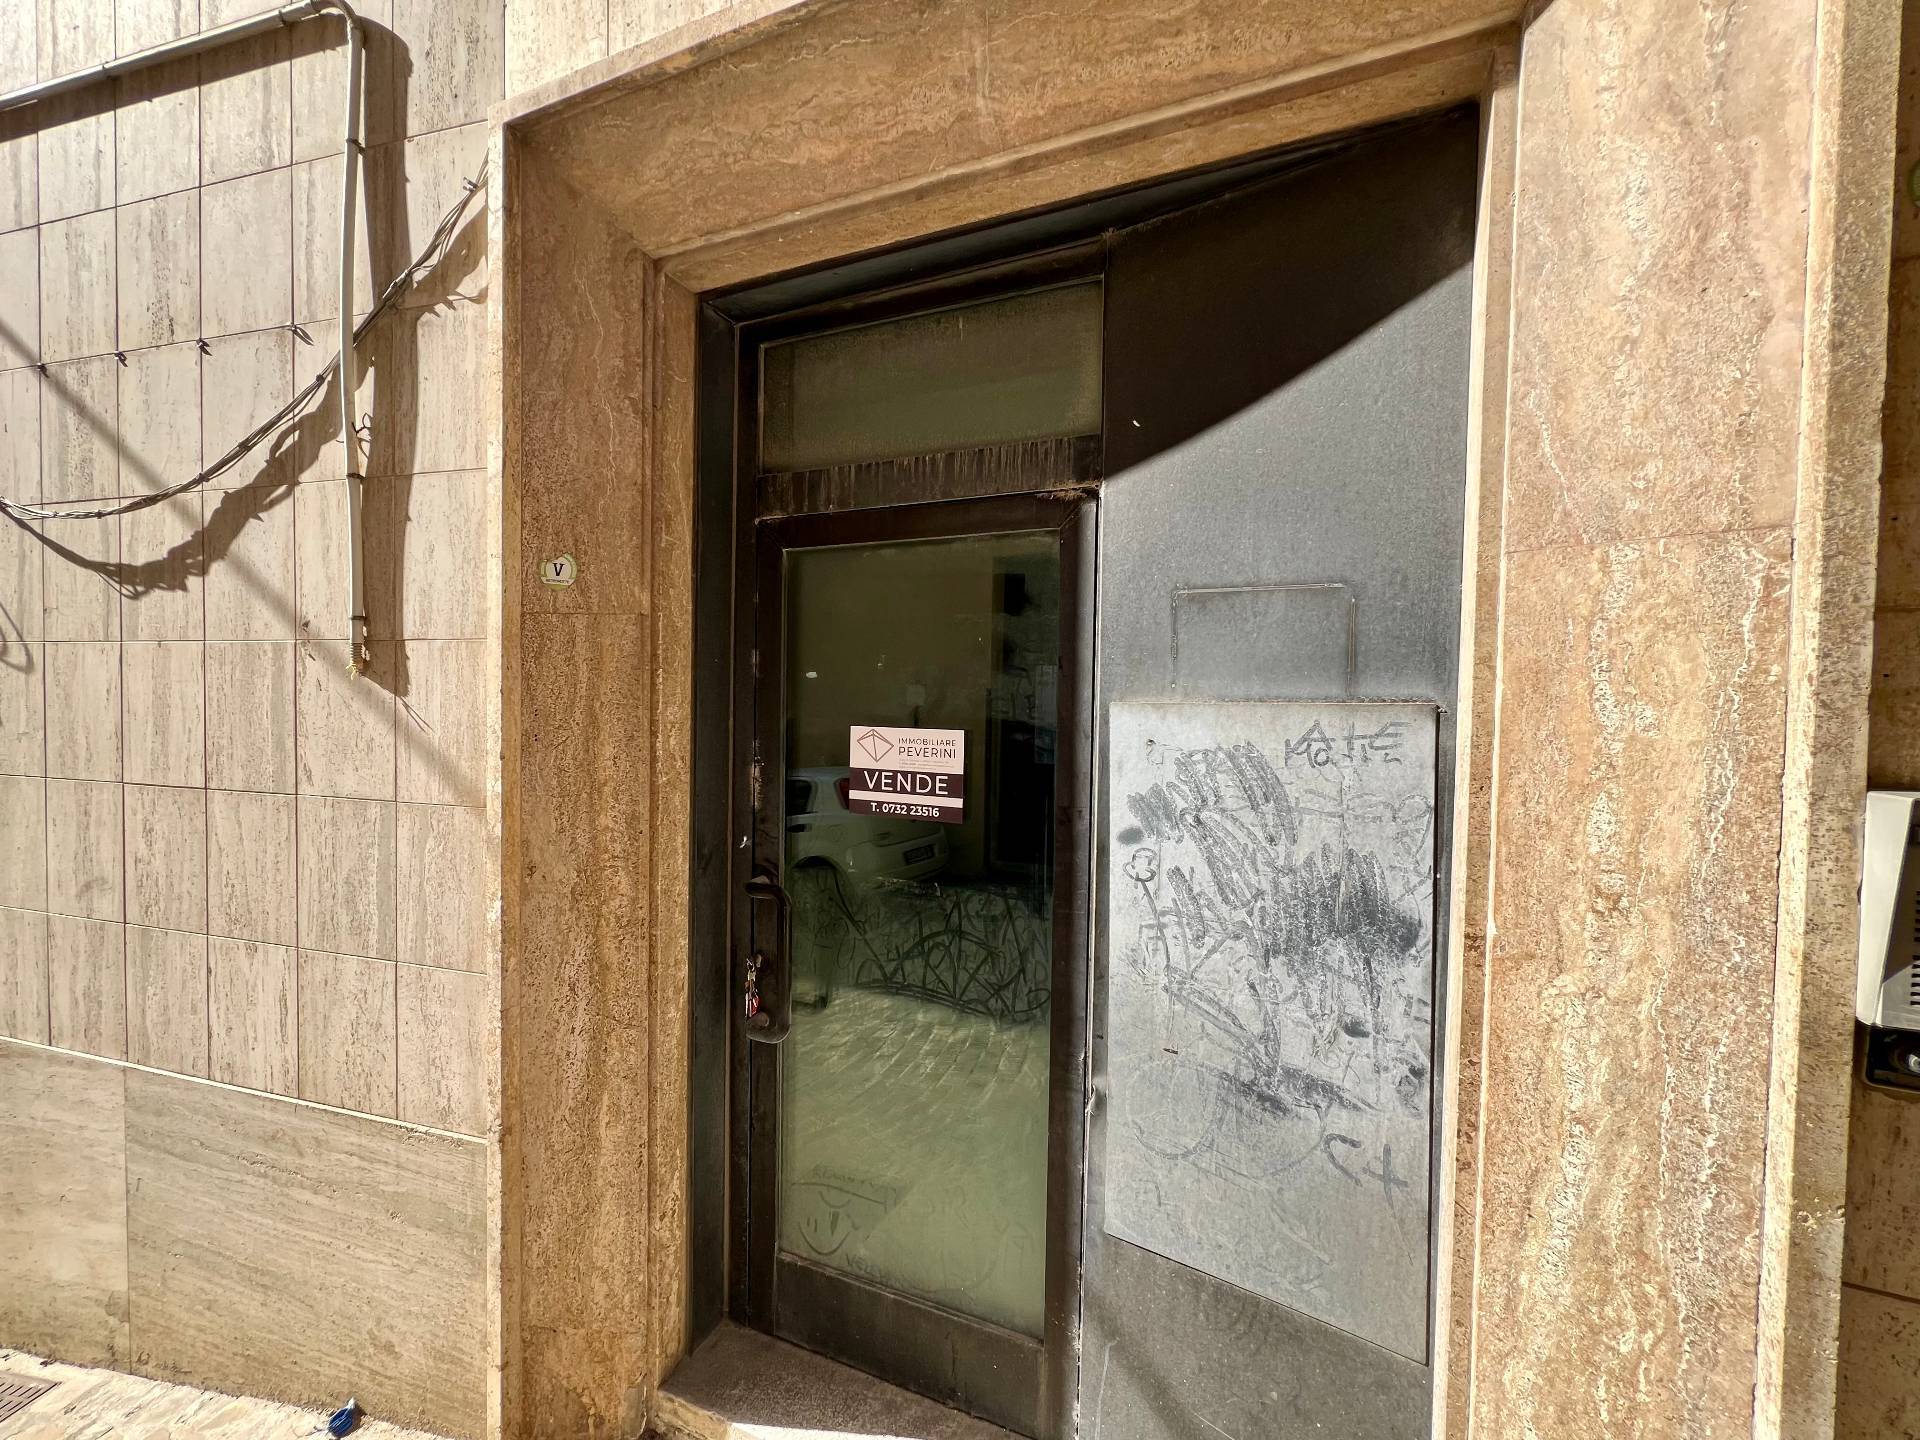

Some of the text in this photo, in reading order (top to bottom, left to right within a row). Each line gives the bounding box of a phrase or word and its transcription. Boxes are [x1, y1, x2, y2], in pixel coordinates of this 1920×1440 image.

[898, 738, 957, 747] IMMOBILIARE
[898, 746, 957, 759] PEVERINI
[863, 770, 949, 795] VENDE
[870, 802, 940, 818] T. 0732 23516
